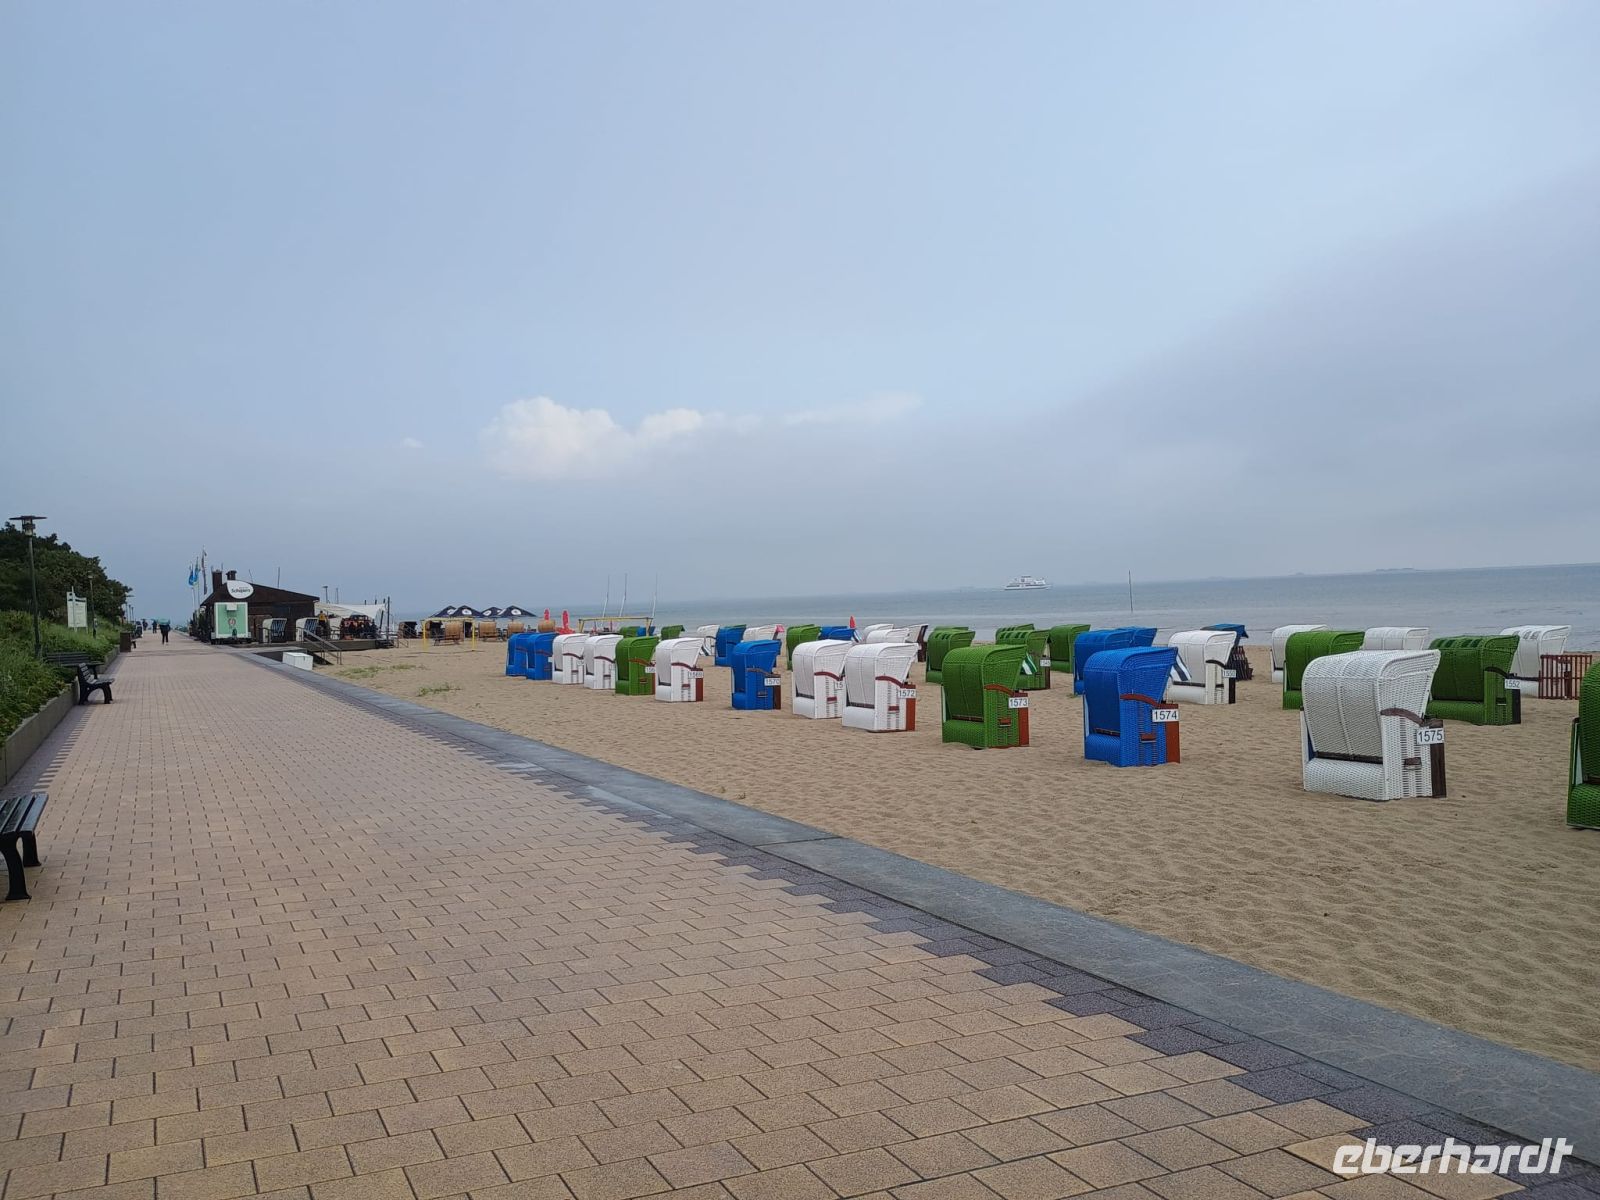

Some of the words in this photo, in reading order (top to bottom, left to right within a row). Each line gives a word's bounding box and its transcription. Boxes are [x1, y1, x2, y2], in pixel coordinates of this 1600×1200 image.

[1505, 679, 1521, 689] 1552
[899, 689, 915, 697] 1572
[1010, 698, 1028, 707] 1573
[1154, 710, 1177, 720] 1574
[1418, 729, 1443, 742] 1575
